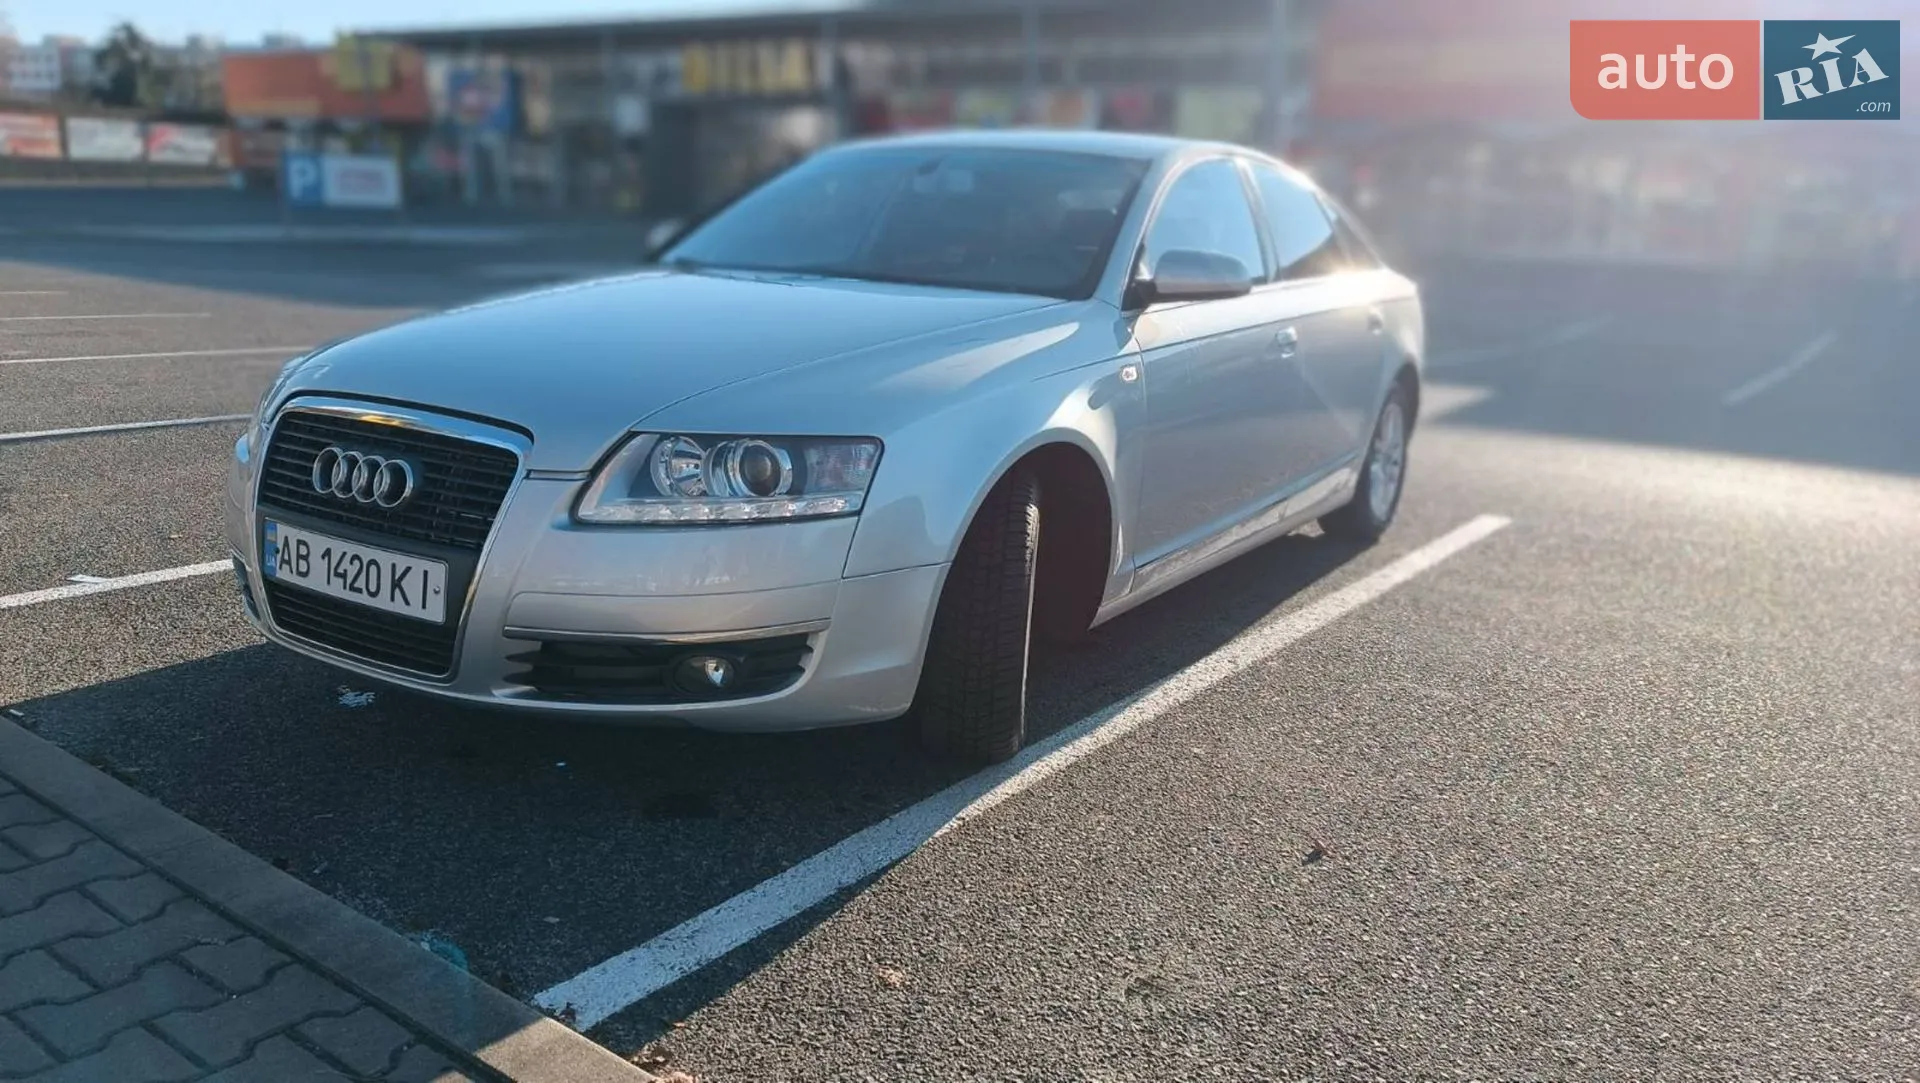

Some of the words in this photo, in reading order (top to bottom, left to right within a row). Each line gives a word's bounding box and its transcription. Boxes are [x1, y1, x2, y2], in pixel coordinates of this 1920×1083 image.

[289, 159, 317, 199] P
[279, 535, 311, 578] AB
[321, 547, 381, 598] 1420
